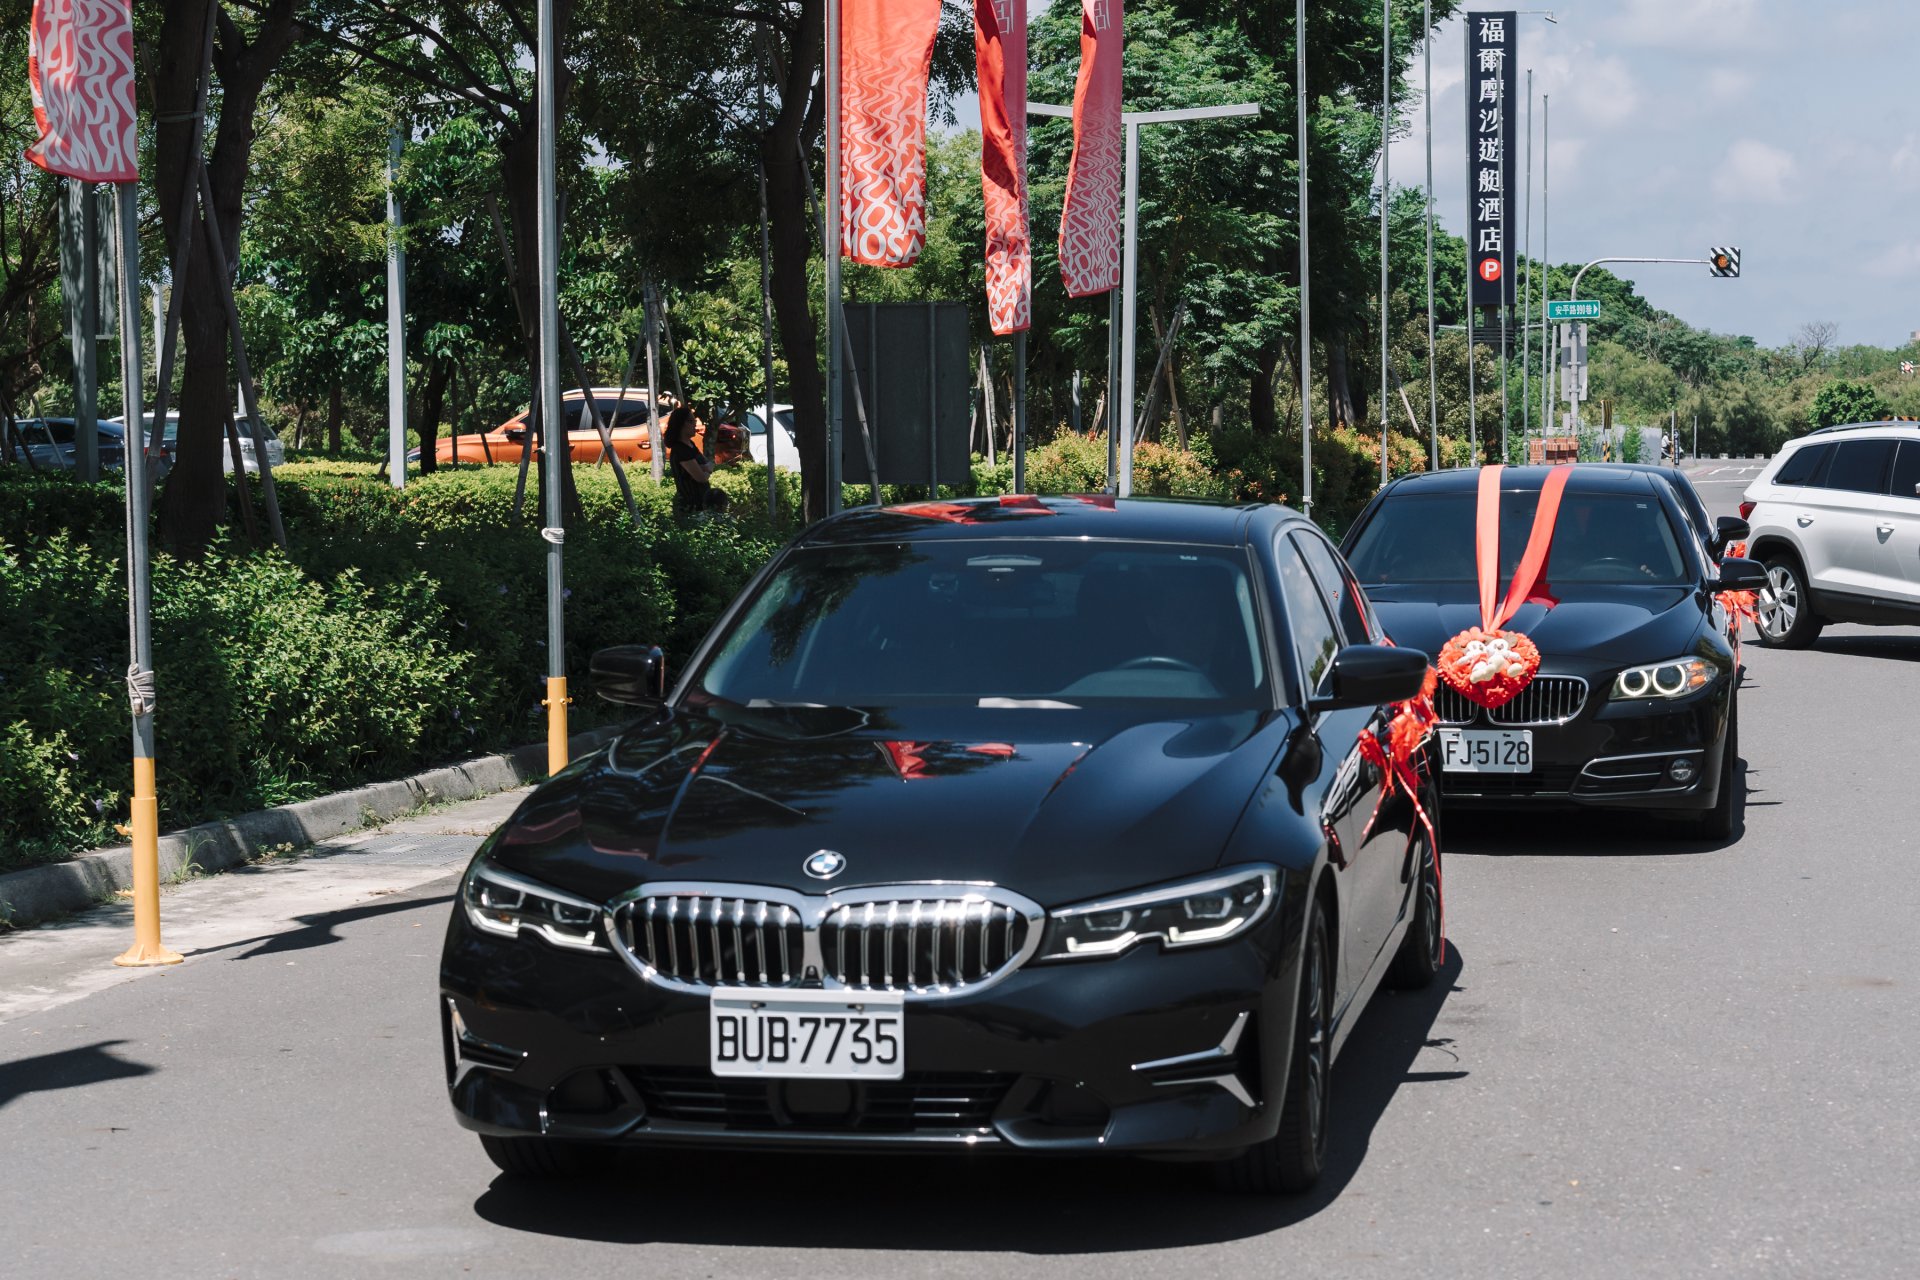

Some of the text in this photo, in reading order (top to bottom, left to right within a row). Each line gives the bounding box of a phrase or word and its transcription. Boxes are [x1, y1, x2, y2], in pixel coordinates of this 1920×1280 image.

[1477, 18, 1506, 252] 福爾摩沙遊艇酒店
[1485, 262, 1498, 278] P
[1444, 740, 1530, 765] FJ·5128
